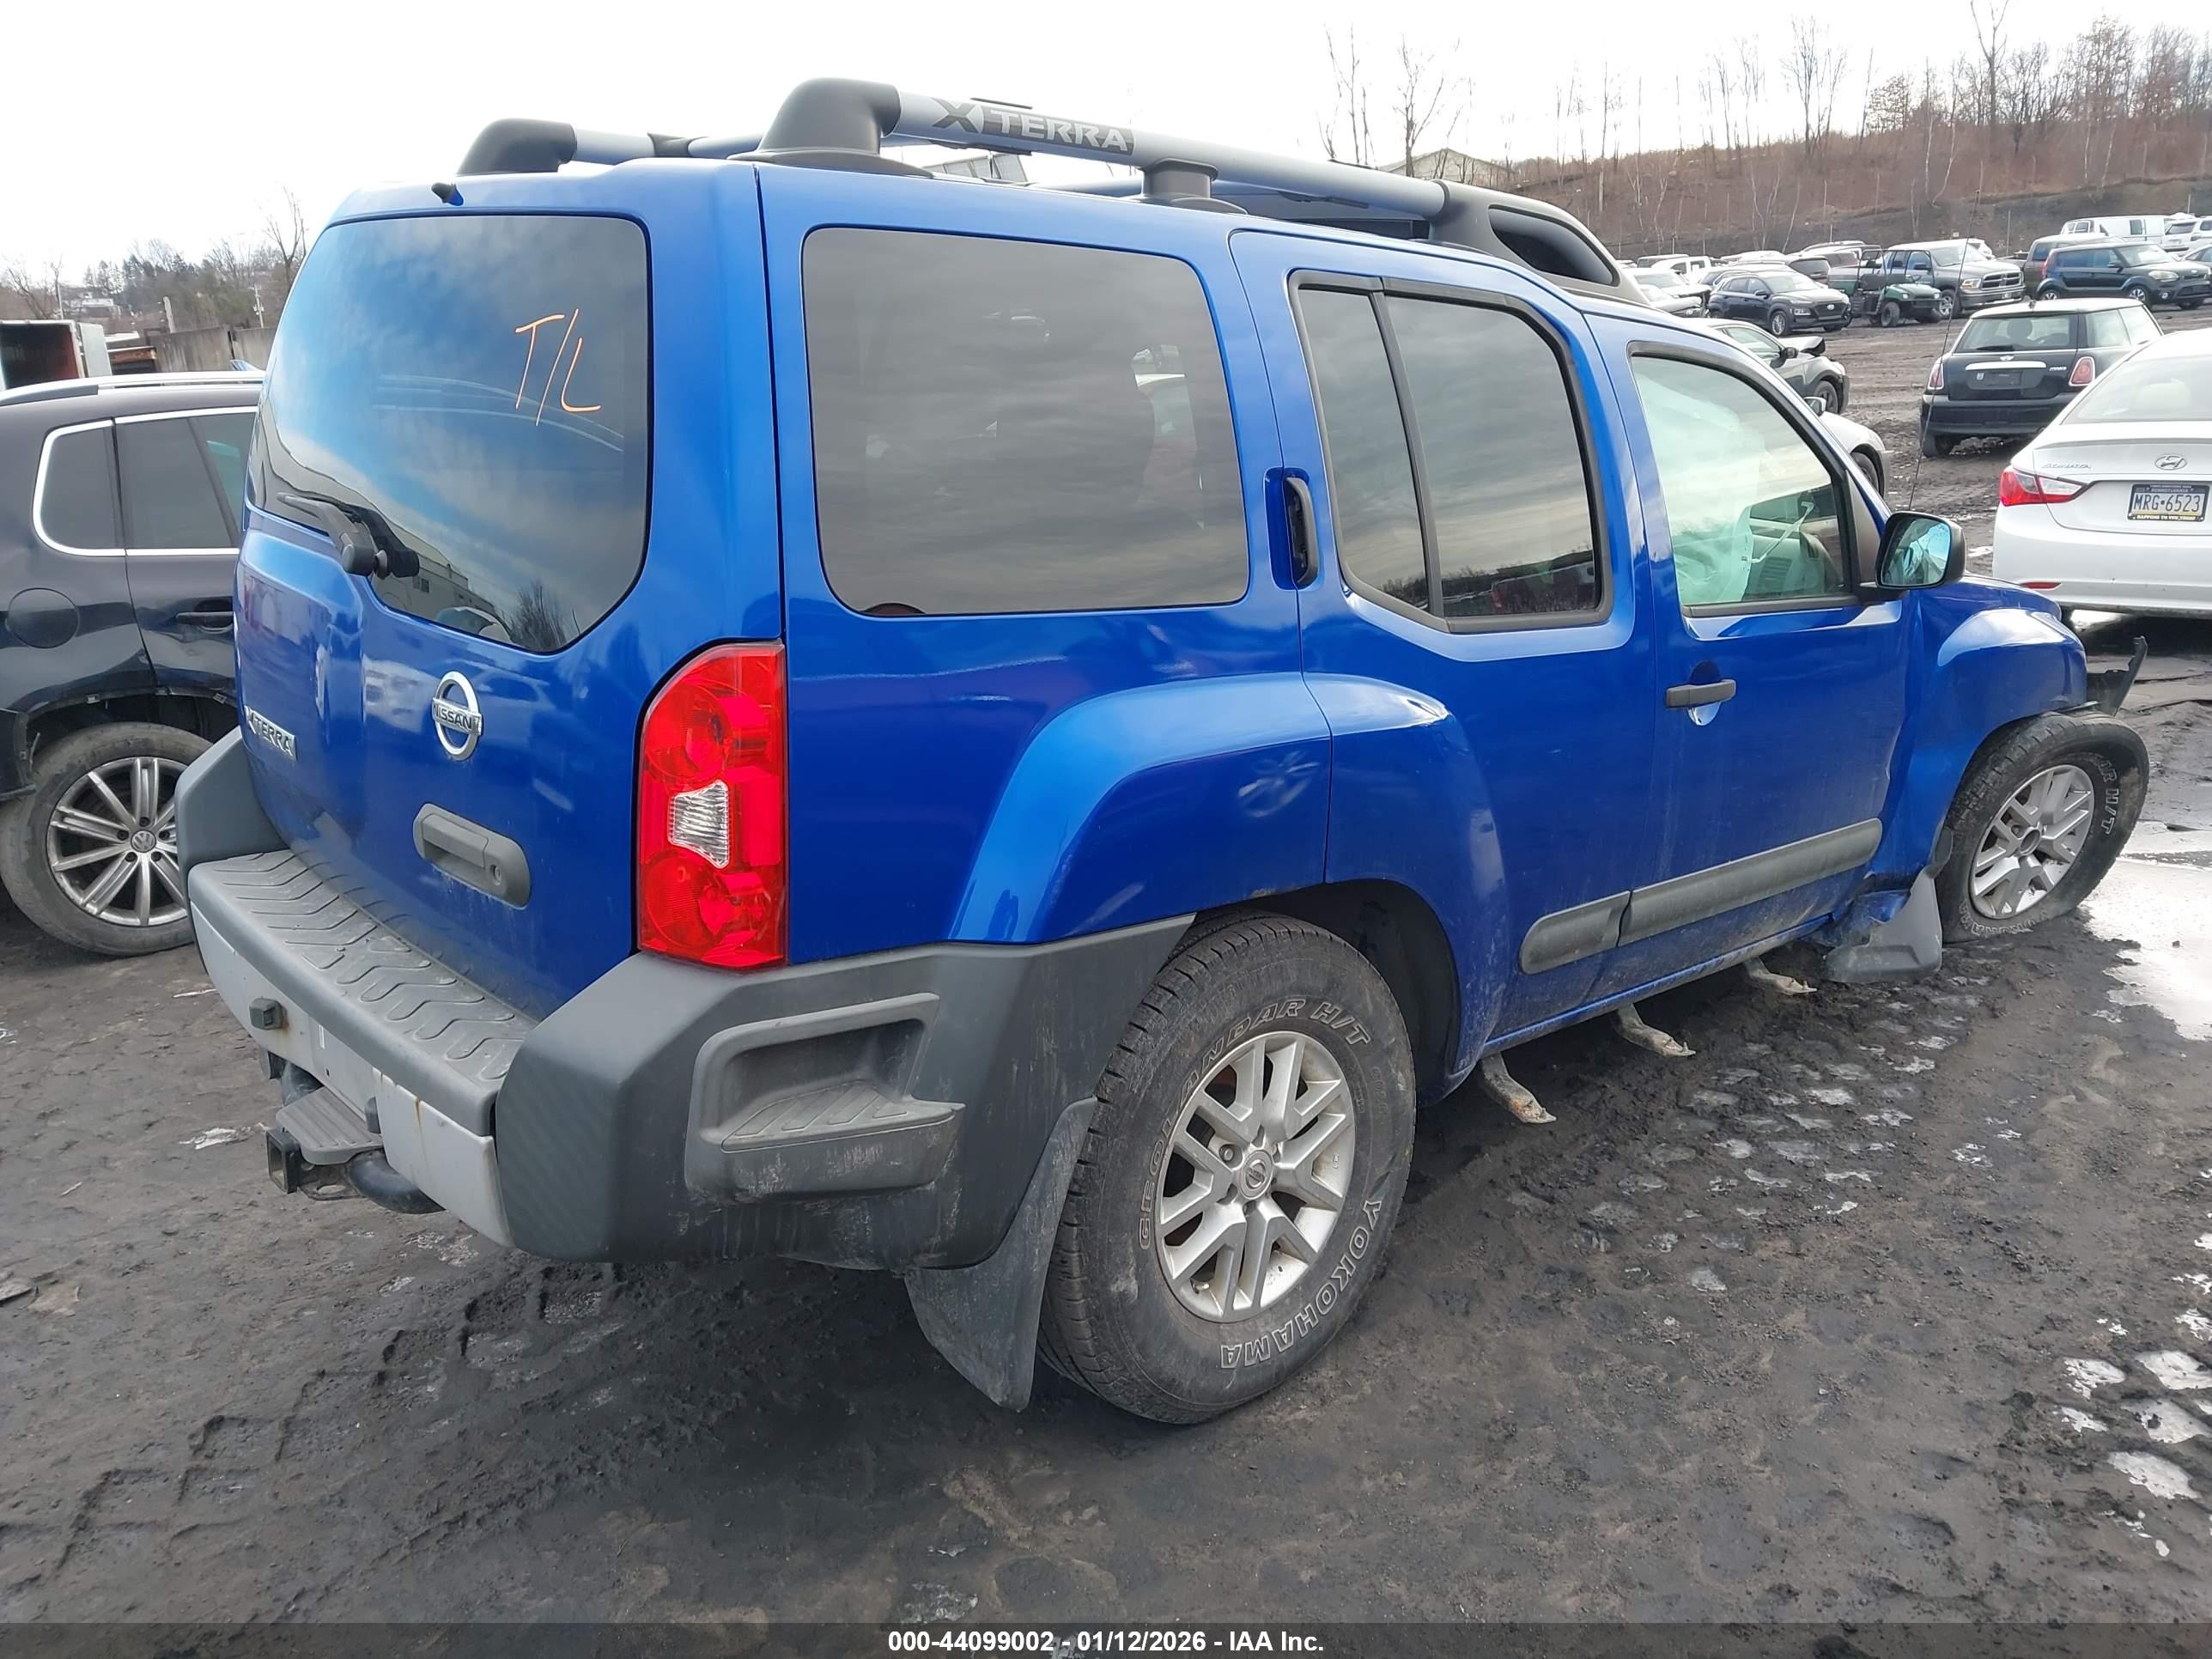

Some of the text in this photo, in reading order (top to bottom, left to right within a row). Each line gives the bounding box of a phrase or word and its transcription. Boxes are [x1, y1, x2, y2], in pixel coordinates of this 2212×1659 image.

[932, 97, 1128, 153] XTERRA
[434, 703, 472, 729] NISSAN
[1310, 1001, 1371, 1045] H/T
[1220, 1200, 1382, 1369] YOKOHAMA
